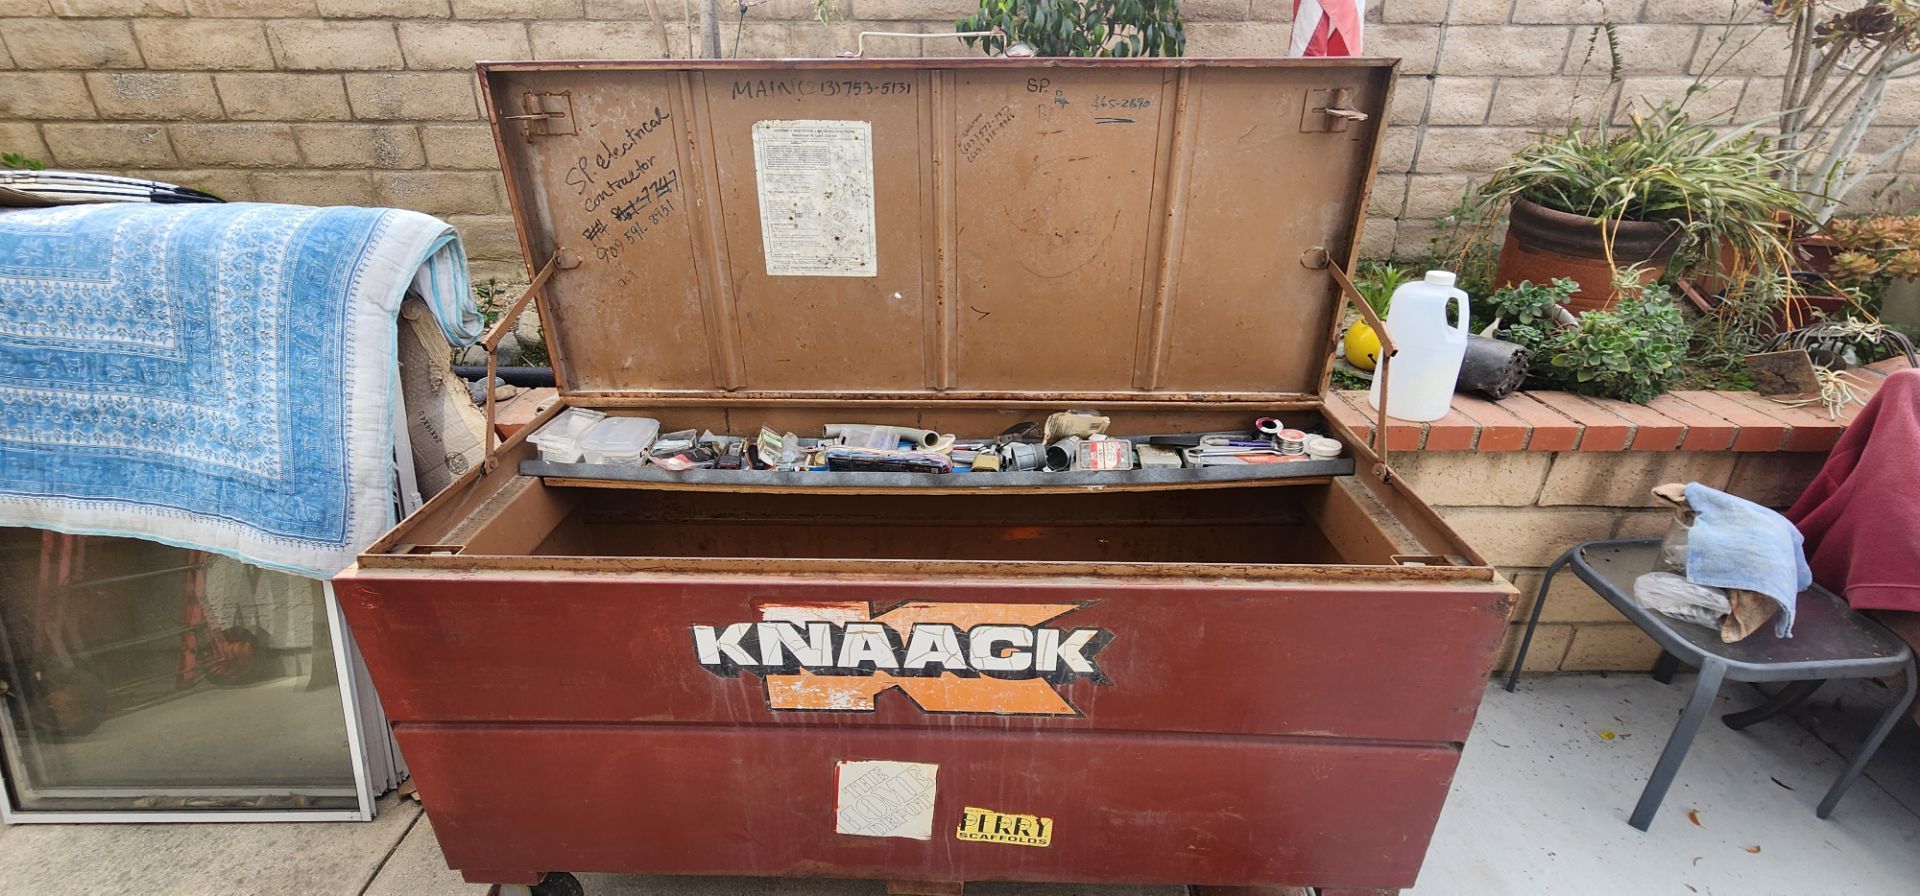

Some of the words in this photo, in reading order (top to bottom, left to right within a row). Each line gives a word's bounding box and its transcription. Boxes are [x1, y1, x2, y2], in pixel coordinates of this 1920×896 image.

[732, 80, 792, 100] MAIN
[692, 621, 1100, 674] KNAACK
[842, 766, 890, 800] THE
[958, 831, 1049, 846] SCAFFOLDS
